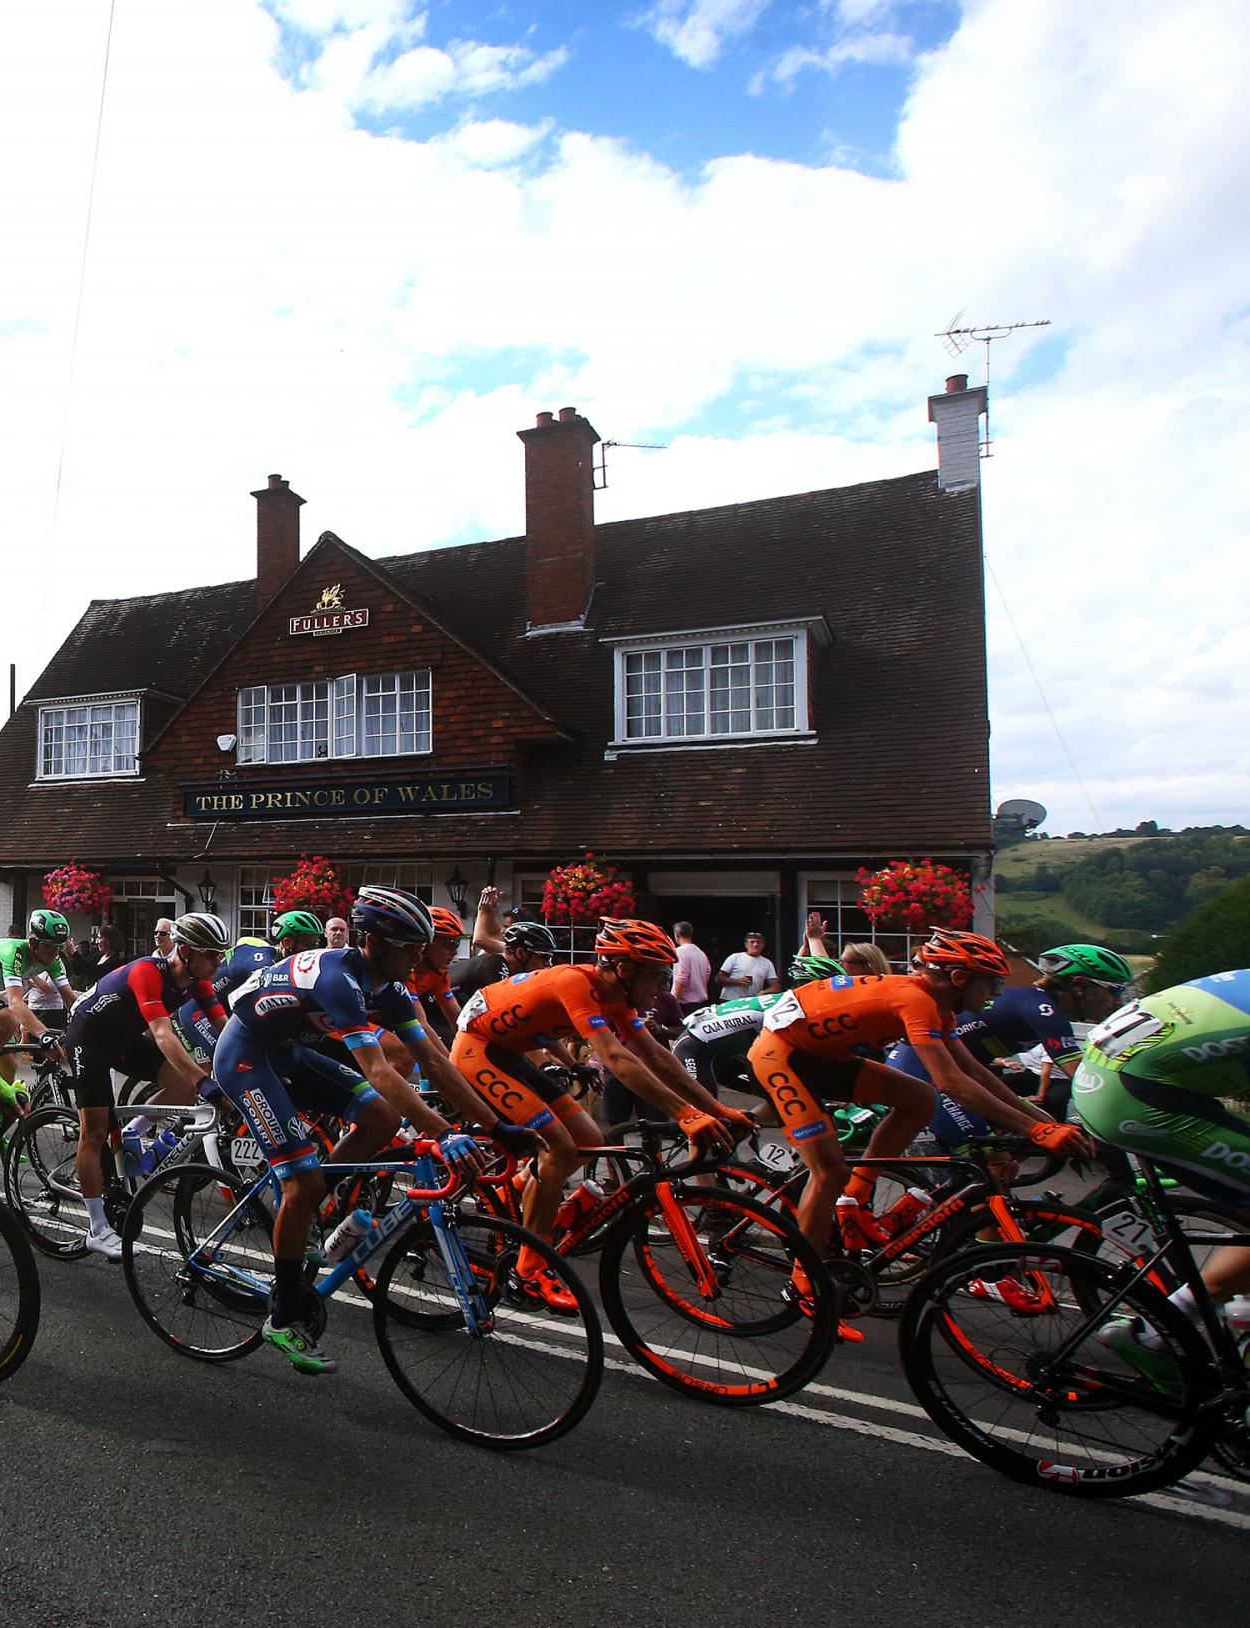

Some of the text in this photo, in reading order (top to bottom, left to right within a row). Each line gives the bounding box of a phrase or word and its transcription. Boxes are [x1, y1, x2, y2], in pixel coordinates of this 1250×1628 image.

[292, 611, 363, 632] FULLER'S
[196, 782, 494, 811] THE PRINCE OF WALES
[212, 976, 231, 993] ORICA
[272, 973, 289, 983] B&R
[85, 992, 122, 1016] YESSS
[489, 1004, 530, 1037] CCC
[702, 1014, 758, 1035] CAJA RURAL
[808, 1013, 858, 1040] CCC
[956, 1021, 988, 1036] ORICA
[476, 1069, 523, 1109] CCC
[767, 1072, 806, 1116] CCC
[243, 1097, 272, 1149] GOBERT
[252, 1092, 285, 1141] GROUPE
[155, 1132, 195, 1176] ARELLO
[234, 1139, 260, 1160] 222
[766, 1144, 786, 1166] 12
[352, 1200, 414, 1264] CUBE
[1112, 1214, 1150, 1243] 21
[450, 1273, 473, 1331] CUBE
